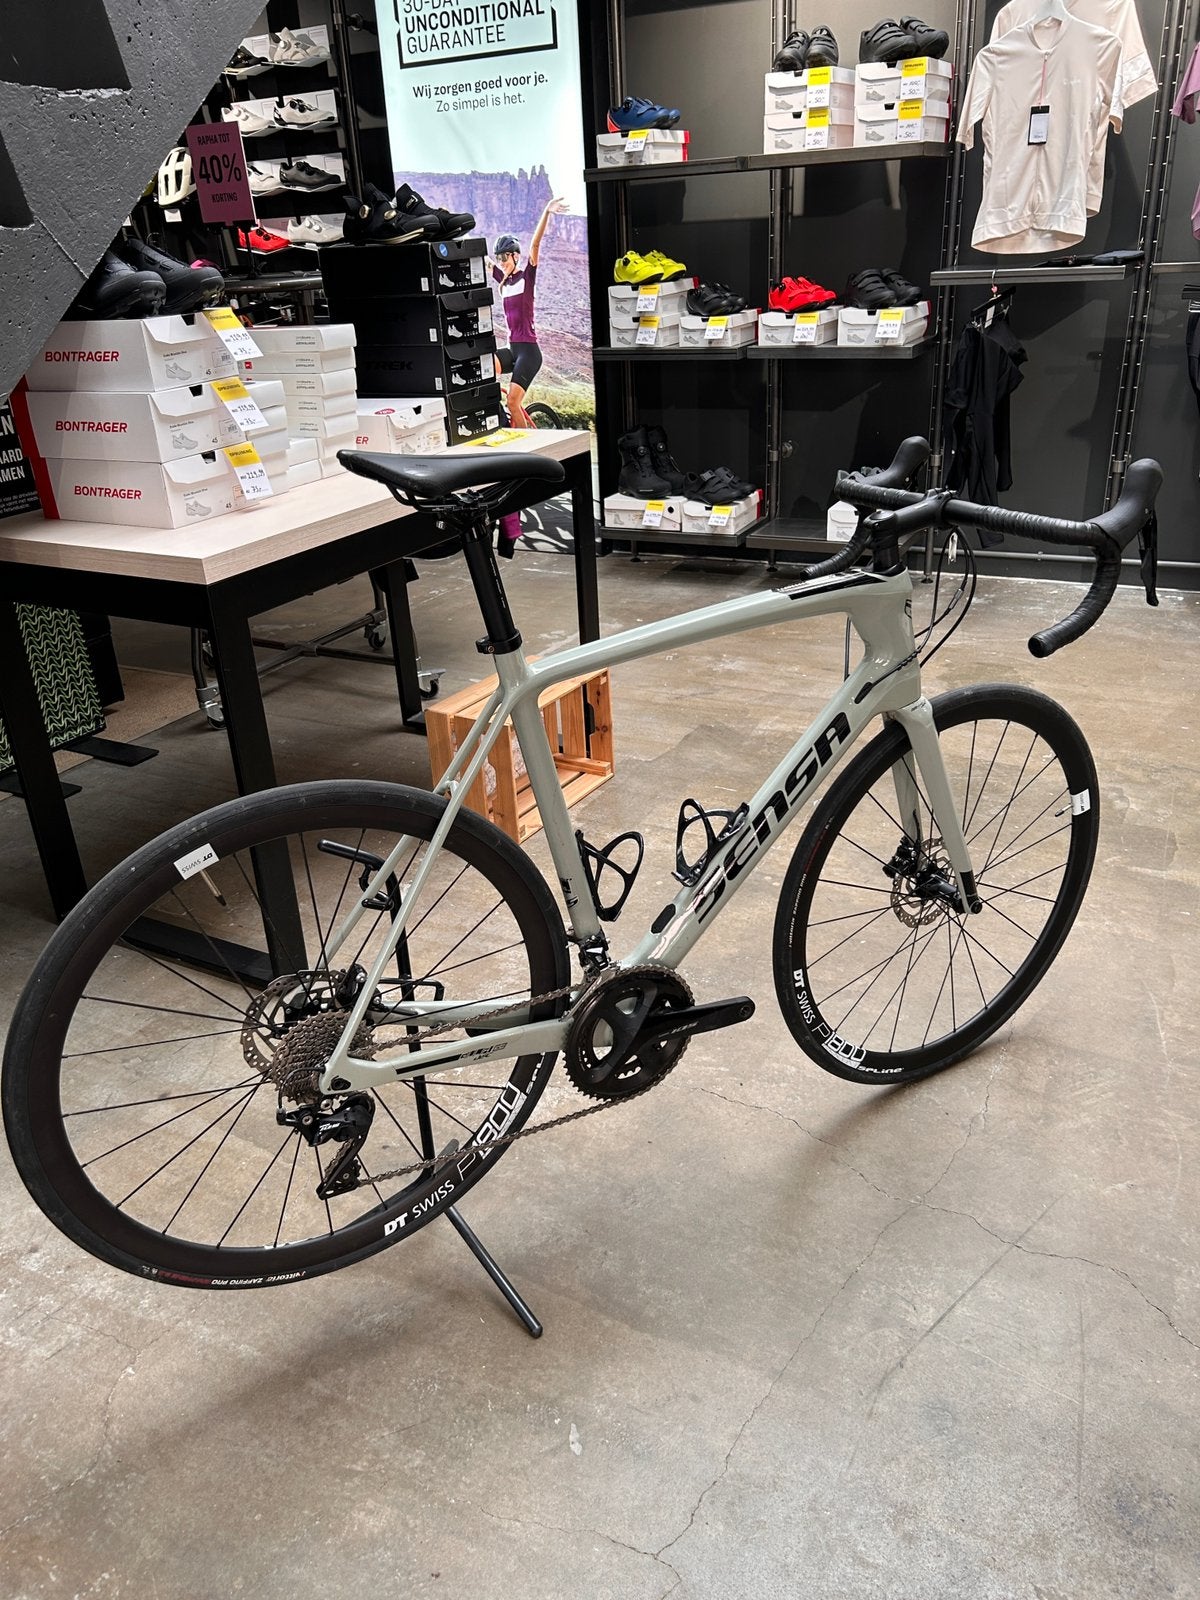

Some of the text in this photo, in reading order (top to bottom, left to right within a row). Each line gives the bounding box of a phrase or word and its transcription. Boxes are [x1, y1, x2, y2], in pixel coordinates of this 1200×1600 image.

[405, 0, 545, 34] UNCONDITIONAL
[407, 24, 506, 54] GUARANTEE
[413, 71, 548, 99] Wij zorgen goed voor je.
[436, 92, 525, 113] Zo simpel is het.
[197, 133, 230, 146] RAPHA TOT
[199, 153, 242, 184] 40%
[211, 192, 238, 203] KORTING
[45, 351, 120, 362] BONTRAGER
[55, 421, 128, 433] BONTRAGER
[0, 448, 24, 465] ARD
[0, 465, 26, 484] MEN
[74, 485, 142, 500] BONTRAGER
[181, 858, 201, 874] SWISS
[793, 968, 805, 988] DT
[797, 990, 816, 1025] SWISS
[384, 1212, 410, 1237] DT
[412, 1179, 455, 1219] SWISS
